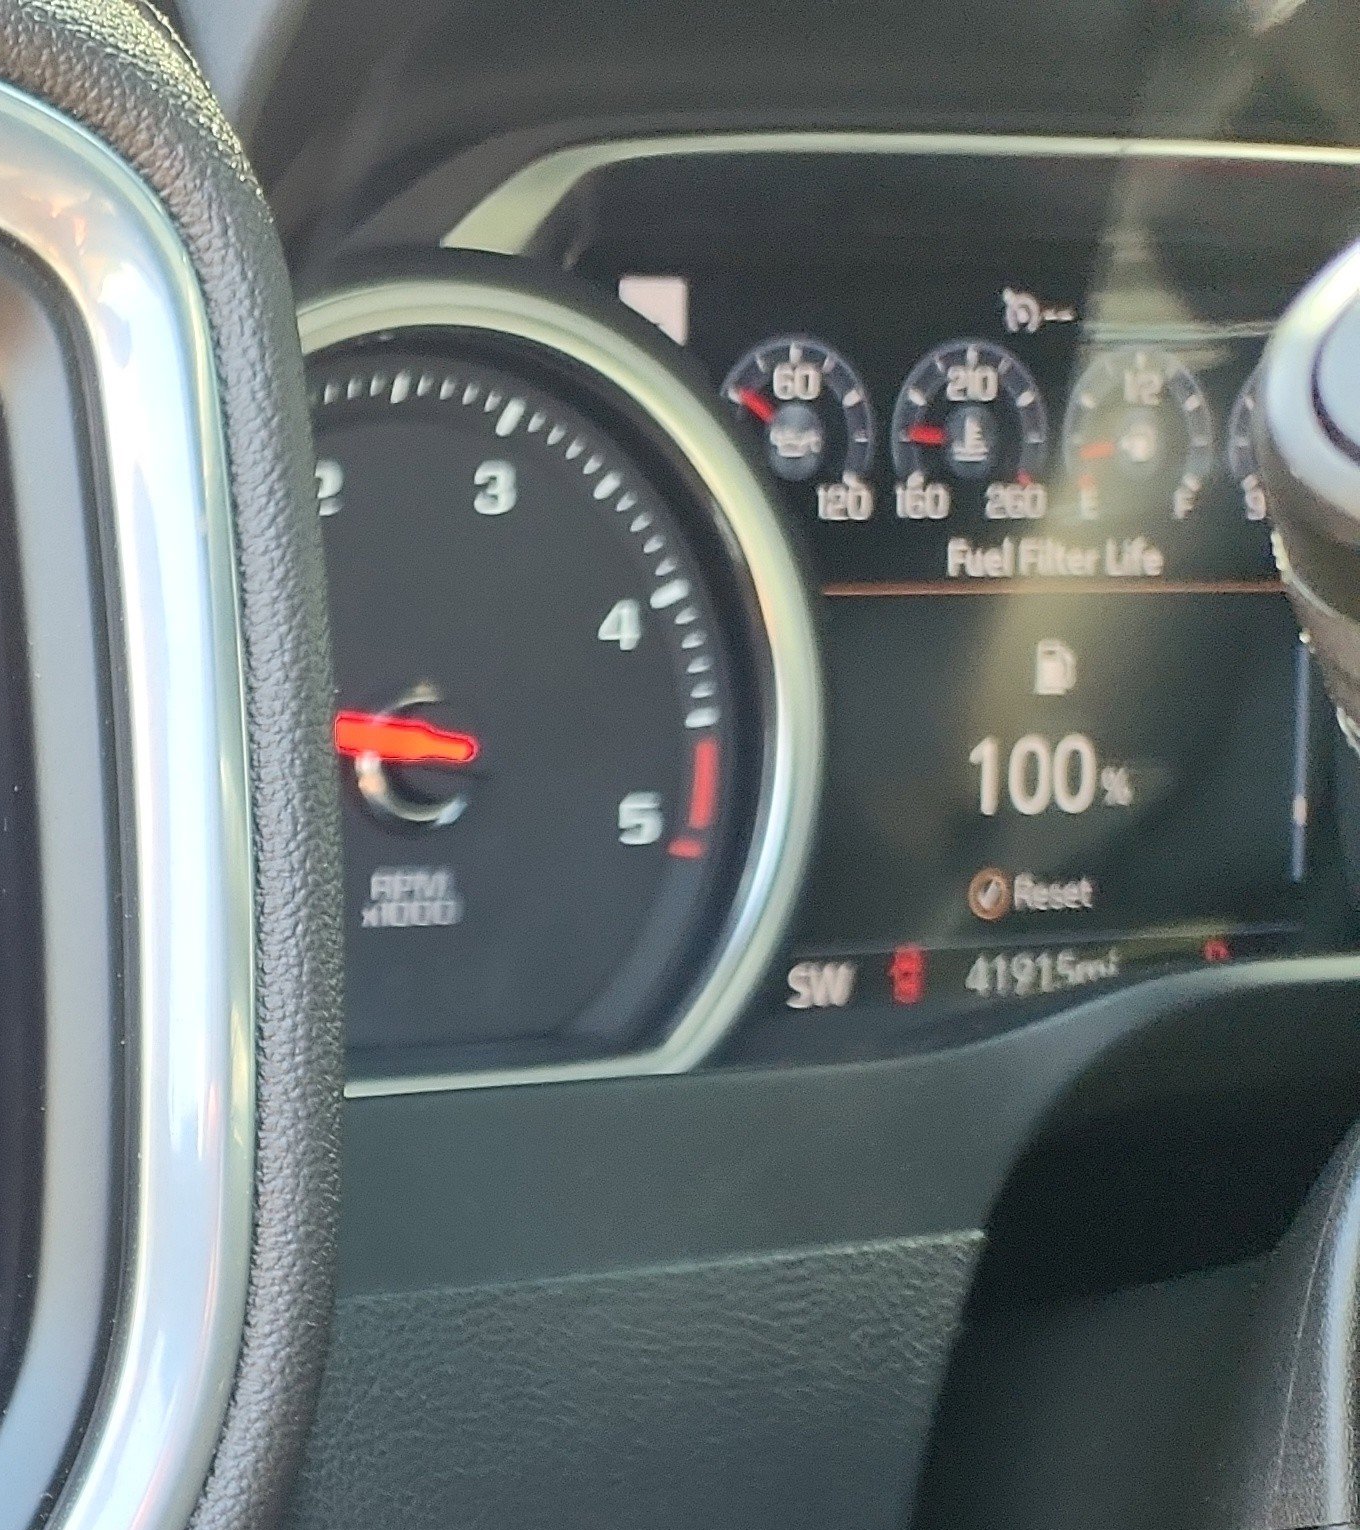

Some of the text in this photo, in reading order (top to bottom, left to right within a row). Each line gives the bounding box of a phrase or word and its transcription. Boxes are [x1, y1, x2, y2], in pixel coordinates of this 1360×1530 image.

[772, 361, 823, 401] 60
[946, 364, 999, 402] 210
[473, 459, 517, 516] 3
[816, 482, 873, 521] 120
[894, 482, 951, 520] 160
[984, 482, 1048, 520] 260
[946, 535, 1165, 577] Fuel Filter Life
[597, 600, 641, 652] 4
[617, 792, 664, 846] 5
[369, 869, 454, 901] RPM
[1013, 873, 1093, 911] Reset
[786, 961, 857, 1009] SW
